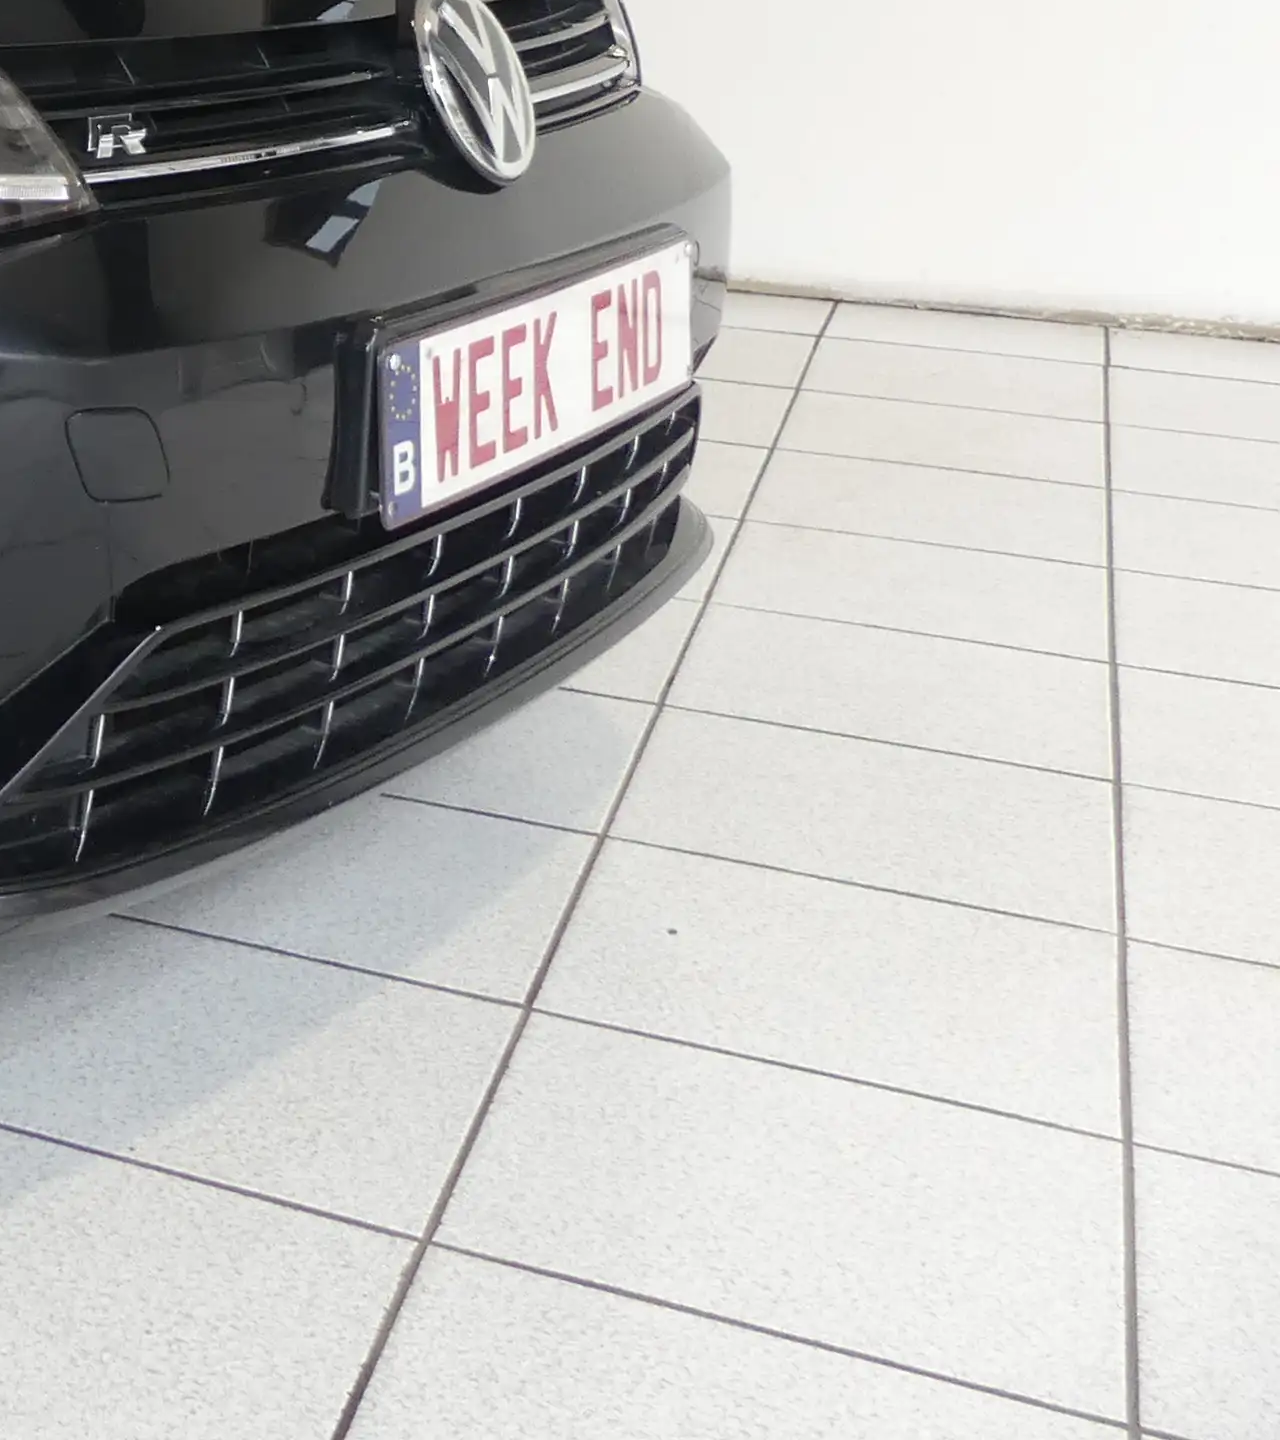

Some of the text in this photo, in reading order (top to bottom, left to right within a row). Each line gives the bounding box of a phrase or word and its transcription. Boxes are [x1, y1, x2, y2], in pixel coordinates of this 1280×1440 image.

[87, 112, 147, 159] R
[431, 269, 663, 484] WEEK END
[392, 439, 416, 497] B
